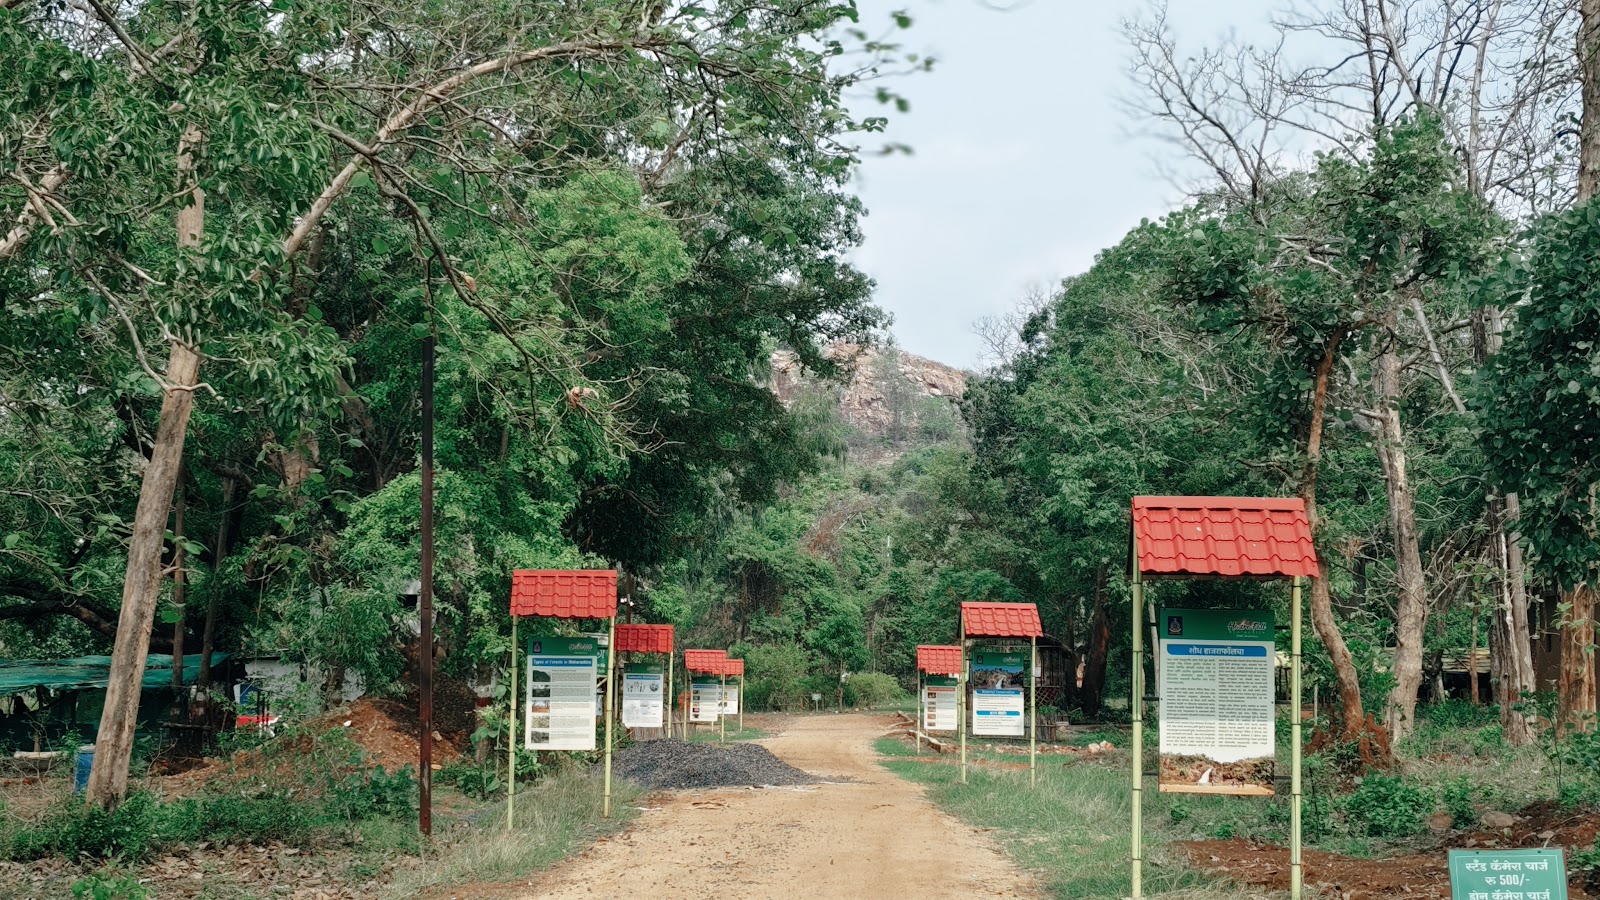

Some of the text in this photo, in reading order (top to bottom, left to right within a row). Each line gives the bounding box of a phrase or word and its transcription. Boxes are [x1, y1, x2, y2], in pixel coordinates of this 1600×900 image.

[1189, 646, 1202, 654] शोध
[1490, 860, 1522, 871] कॅमेरा
[1525, 859, 1548, 871] चार्ज
[1500, 874, 1530, 886] 500/-
